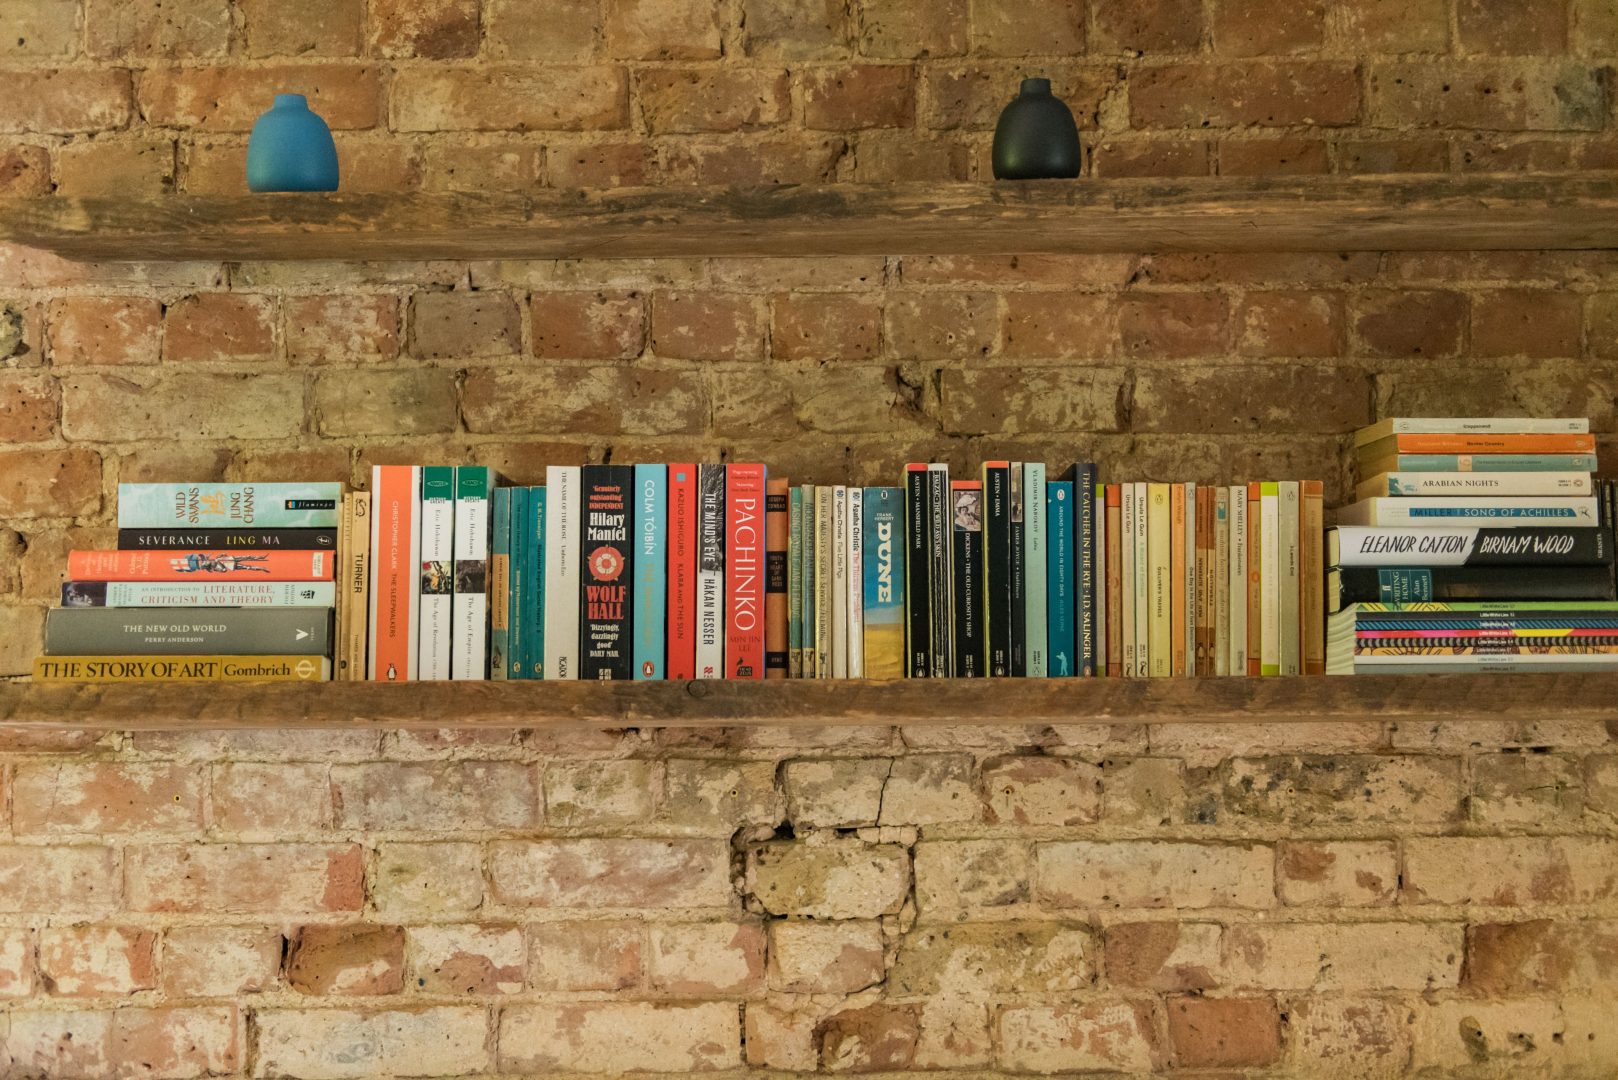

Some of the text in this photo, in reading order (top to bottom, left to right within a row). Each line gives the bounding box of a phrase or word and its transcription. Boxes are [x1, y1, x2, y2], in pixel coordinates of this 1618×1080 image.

[176, 492, 186, 518] WILD
[189, 487, 199, 524] SWANS
[231, 492, 242, 519] JUNG
[244, 487, 254, 524] CHANG
[644, 479, 655, 513] COLM
[704, 492, 716, 509] THE
[589, 502, 624, 510] INDEPENDENT
[852, 504, 860, 526] Agatha
[1464, 508, 1496, 516] SONG
[1501, 508, 1514, 516] OF
[1520, 508, 1569, 516] ACHILLES
[589, 512, 625, 528] Hilary
[139, 535, 280, 545] SEVERANCE LING MA
[587, 527, 626, 541] Mantel
[644, 517, 657, 555] TÓIBÍN
[704, 546, 716, 562] EYE
[1360, 535, 1574, 554] ELEANOR CATTON BIRNAM WOOD
[735, 498, 756, 631] PACHINKO
[878, 522, 892, 603] DUNE
[1082, 472, 1091, 660] THE CATCHER IN THE RYE SALINGER
[354, 553, 363, 594] TURNER
[141, 595, 274, 604] CRITICISM AND THEORY
[203, 584, 275, 596] LITERATURE,
[586, 585, 626, 602] WOLF
[389, 588, 397, 638] SLEEPWALKERS
[466, 611, 474, 622] Age
[588, 602, 624, 620] HALL
[123, 624, 226, 633] THE NEW OLD WORLD
[703, 611, 715, 645] NESSER
[466, 633, 474, 654] Empire
[41, 662, 291, 678] THE STORY OF ART Gombrich
